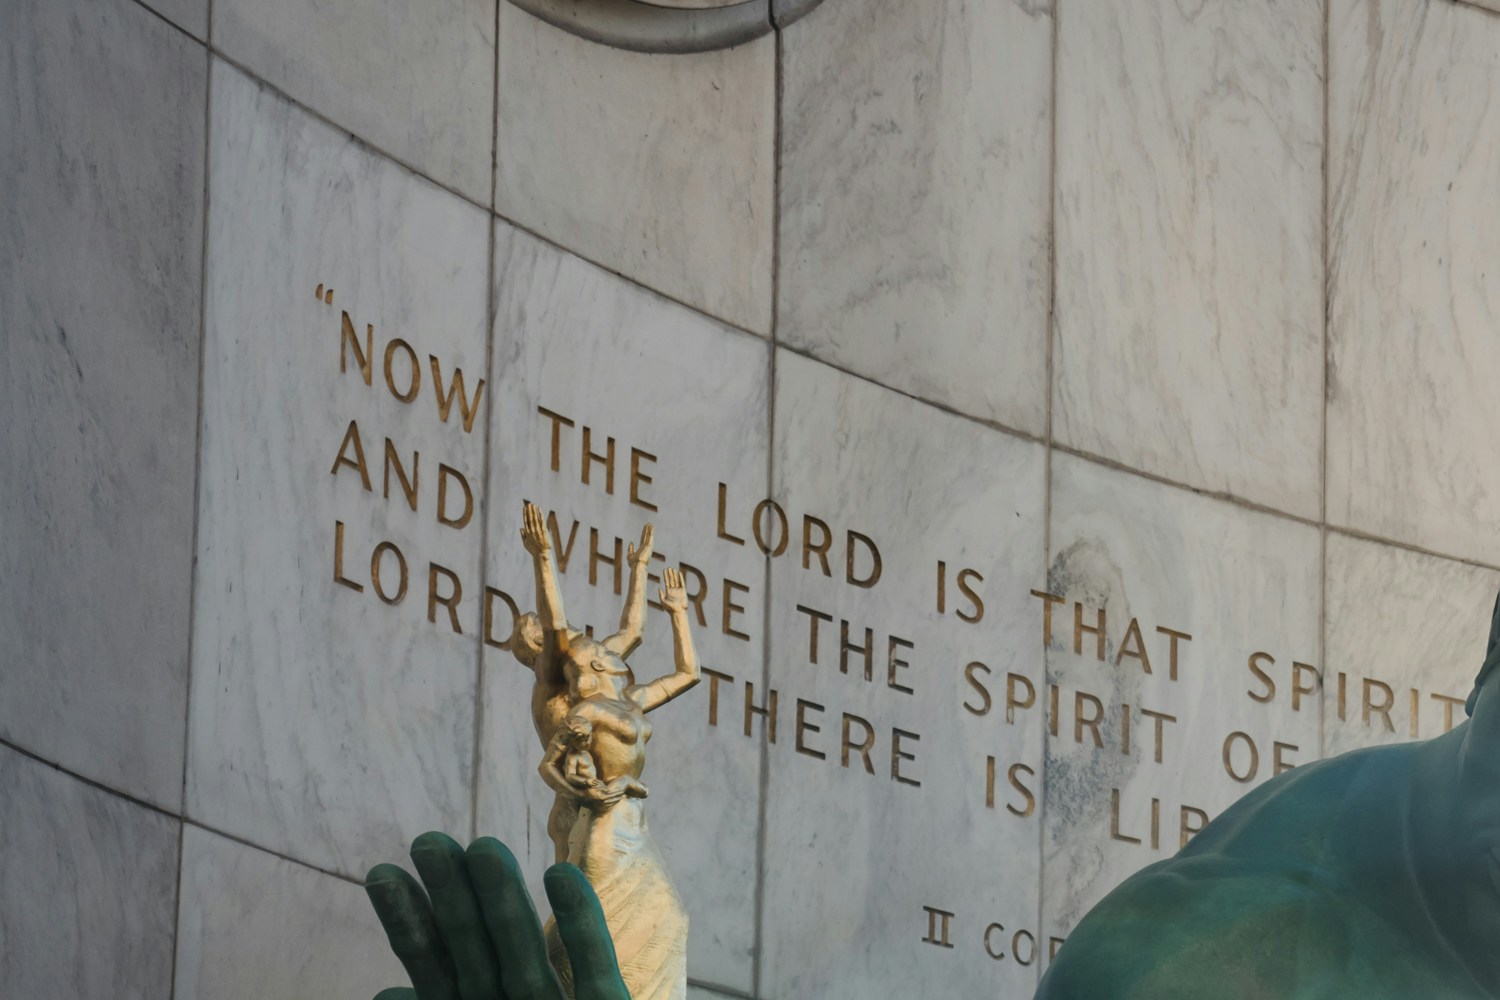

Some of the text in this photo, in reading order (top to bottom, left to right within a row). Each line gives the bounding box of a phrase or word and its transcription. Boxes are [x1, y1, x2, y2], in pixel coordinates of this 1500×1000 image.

[331, 419, 474, 530] AND
[796, 604, 915, 695] THE
[963, 661, 1177, 764] SPIRIT
[1222, 731, 1299, 784] OF
[333, 520, 521, 652] LORD
[700, 666, 921, 788] THERE
[985, 755, 1036, 819] IS
[537, 406, 658, 513] THE
[716, 481, 883, 589] LORD
[936, 560, 985, 624] IS
[1030, 589, 1193, 682] THAT
[1247, 651, 1467, 738] SPIRIT
[921, 905, 955, 949] II
